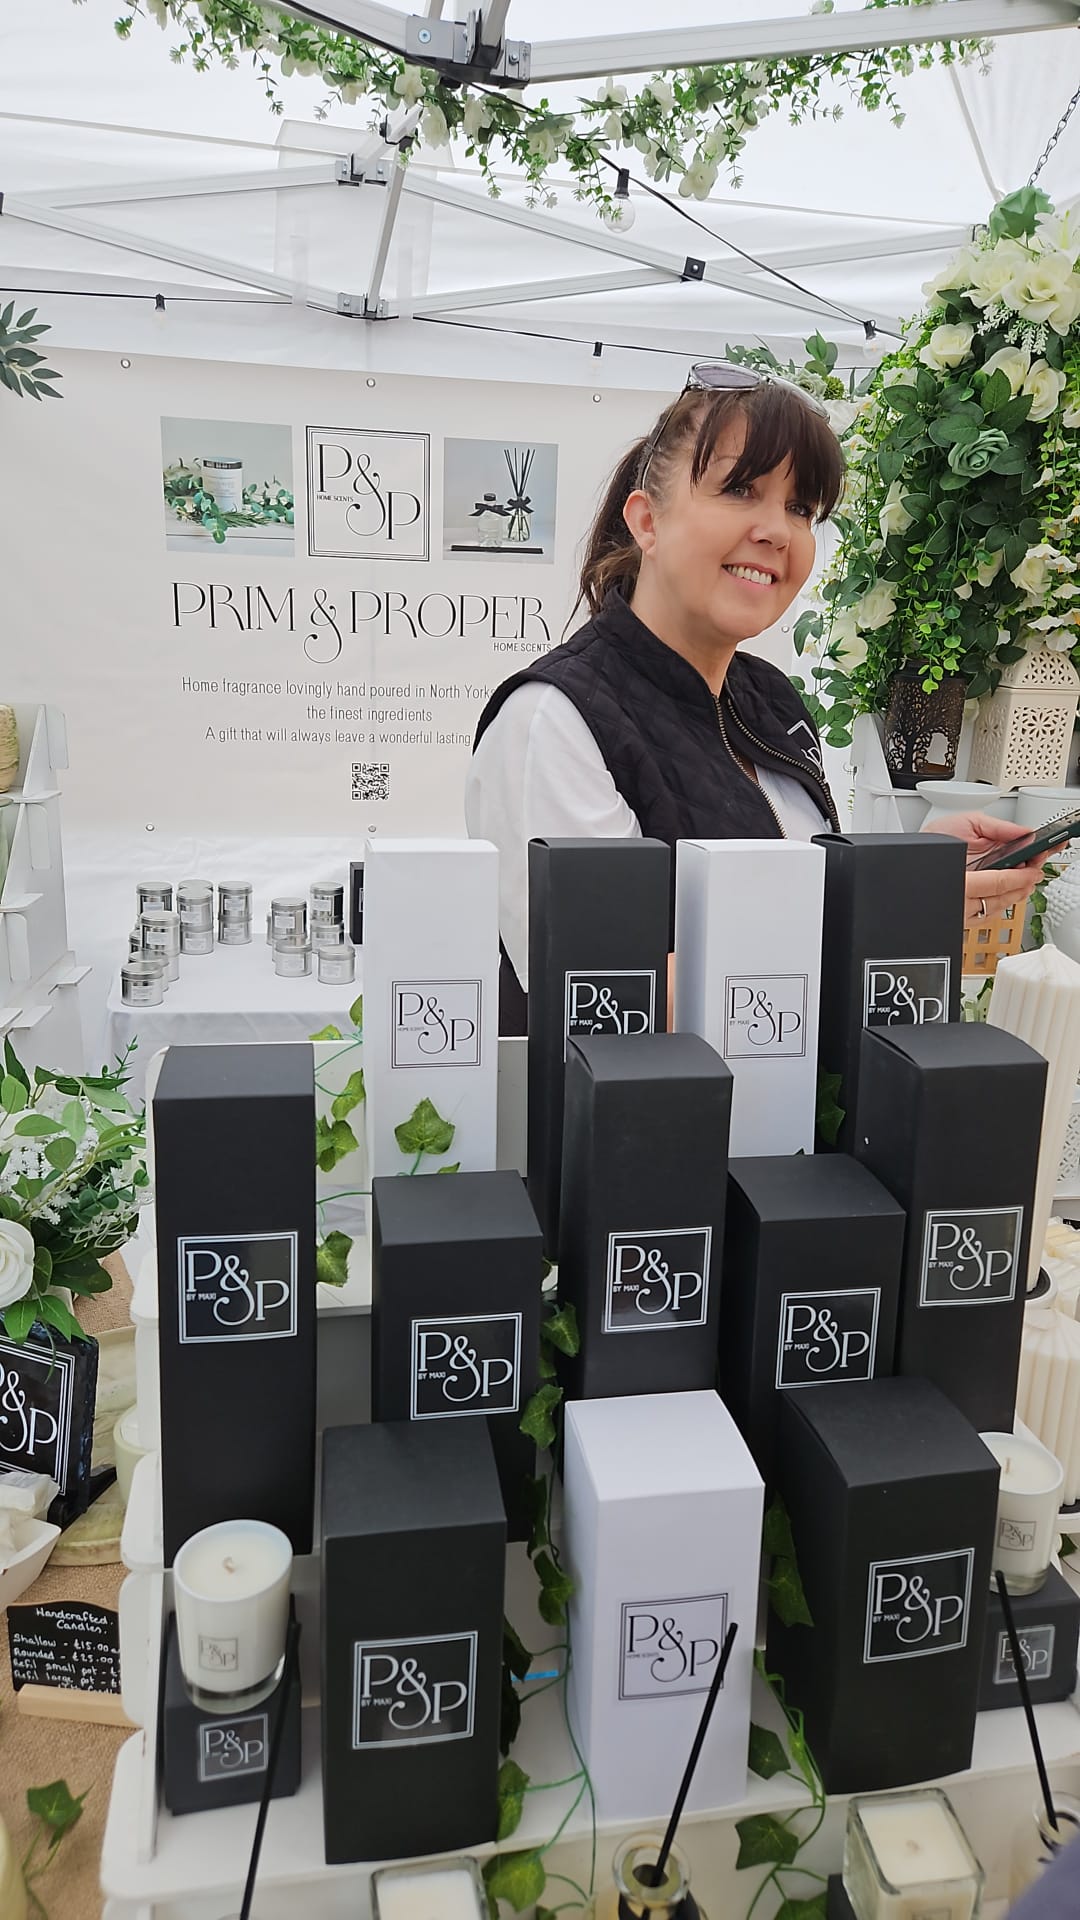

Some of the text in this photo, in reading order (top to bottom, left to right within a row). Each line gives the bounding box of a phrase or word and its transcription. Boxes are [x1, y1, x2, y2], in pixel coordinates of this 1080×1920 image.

[316, 443, 421, 540] P&P
[171, 582, 551, 664] PRIM & PROPER
[493, 642, 552, 652] HOME SCENTS
[182, 676, 219, 693] Home
[222, 678, 282, 696] fragrance
[286, 680, 332, 699] lovingly
[336, 681, 366, 697] hand
[370, 683, 411, 699] poured
[415, 684, 426, 698] in
[429, 684, 460, 699] North
[307, 705, 433, 724] the finest ingredients
[205, 726, 471, 747] A gift that will always leave a wonderful lasting
[397, 992, 475, 1054] P&P
[730, 986, 801, 1046] P&P
[186, 1250, 290, 1326] P&P
[613, 1245, 702, 1315] P&P
[929, 1223, 1012, 1291] P&P
[417, 1332, 513, 1402] P&P
[784, 1305, 870, 1373] P&P
[0, 1364, 58, 1455] &P
[873, 1573, 963, 1643] P&P
[13, 1633, 56, 1647] Shallow
[73, 1638, 109, 1652] £15.00
[13, 1647, 55, 1660] Rounded
[72, 1651, 114, 1664] £25.00
[45, 1662, 76, 1674] small
[627, 1614, 719, 1683] P&P
[361, 1654, 467, 1730] P&P
[205, 1729, 263, 1768] P&P
